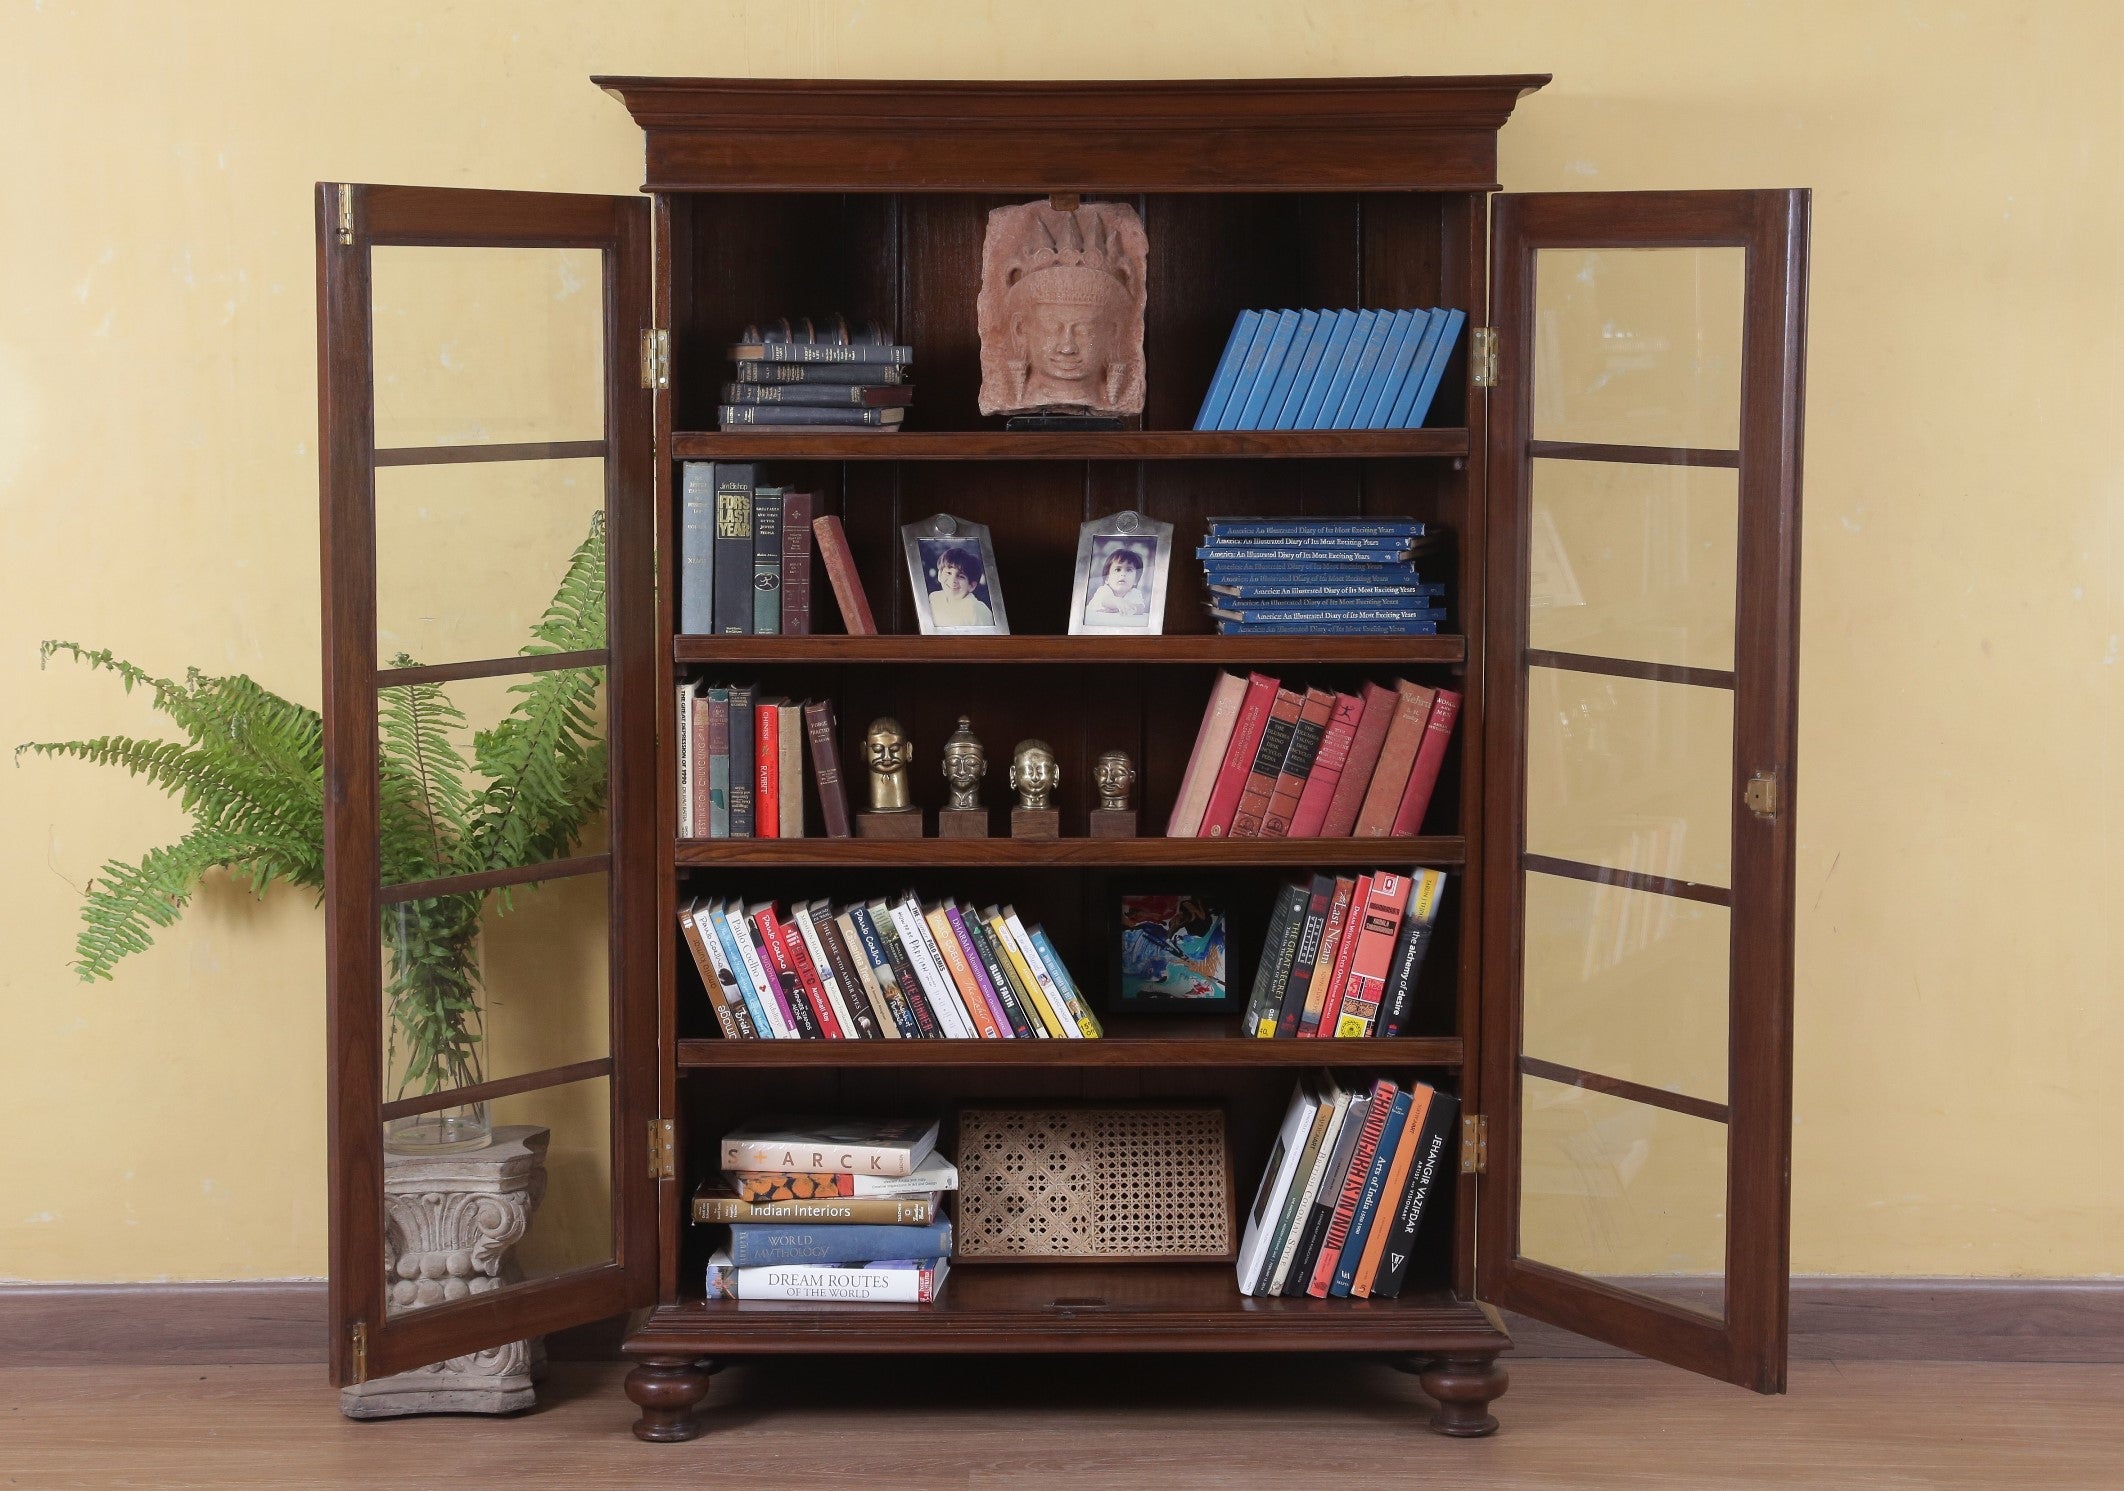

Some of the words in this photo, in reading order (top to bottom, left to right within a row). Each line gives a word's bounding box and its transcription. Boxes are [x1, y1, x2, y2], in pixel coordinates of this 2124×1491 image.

[719, 509, 750, 523] LAST
[719, 522, 750, 537] YEAR
[1247, 551, 1276, 559] Illustrated
[1277, 552, 1295, 562] Diary
[1312, 552, 1327, 560] Most
[1328, 552, 1353, 562] Exciting
[1354, 553, 1370, 561] Years
[1254, 537, 1284, 545] Illustrated
[1285, 537, 1302, 547] Diary
[1320, 538, 1335, 546] Most
[1337, 538, 1362, 548] Exciting
[1363, 538, 1379, 546] Years
[1323, 586, 1340, 595] Diary
[1374, 586, 1399, 595] Exciting
[1293, 612, 1324, 620] Illustrated
[1325, 612, 1342, 621] Diary
[1360, 612, 1374, 620] Most
[1375, 612, 1400, 621] Exciting
[1400, 611, 1417, 619] Years
[760, 765, 768, 795] RABBIT
[698, 786, 706, 836] DESTINATION
[1331, 902, 1343, 926] Last
[700, 916, 712, 940] Paulo
[709, 940, 724, 968] Coelho
[762, 914, 776, 939] Paulo
[772, 940, 787, 969] Coelho
[855, 909, 869, 934] Paulo
[865, 936, 881, 965] Coelho
[911, 907, 920, 918] THE
[926, 939, 936, 954] POLO
[933, 952, 946, 972] GAMES
[933, 915, 949, 939] PAULO
[946, 938, 965, 972] COELHO
[1291, 922, 1301, 940] THE
[1320, 926, 1341, 964] Nizam
[1410, 929, 1421, 945] the
[732, 918, 747, 944] Paulo
[743, 944, 761, 978] Coelho
[844, 930, 863, 967] Casuarina
[859, 966, 871, 983] Tree
[953, 918, 971, 952] DHARMA
[968, 952, 984, 982] Moments
[1283, 940, 1296, 969] GREAT
[1400, 944, 1417, 981] alchemy
[761, 954, 774, 984] BUDDHA
[821, 921, 829, 936] THE
[827, 936, 839, 956] HARE
[842, 971, 855, 994] AMBER
[851, 993, 862, 1010] EYES
[791, 945, 816, 986] Empire
[811, 987, 827, 1012] Arundhati
[821, 1010, 830, 1023] Roy
[990, 963, 1005, 986] BLIND
[1000, 986, 1015, 1009] FAITH
[1275, 970, 1289, 1001] SECRET
[1399, 979, 1409, 992] of
[902, 973, 917, 996] KITE
[911, 995, 933, 1031] RUNNER
[1392, 989, 1407, 1016] desire
[734, 1007, 750, 1035] Brida
[800, 1010, 813, 1031] STANDS
[1349, 1085, 1394, 1178] CHANDIGARH
[1309, 1152, 1326, 1189] BRITISH
[1373, 1155, 1386, 1176] Arts
[1413, 1160, 1423, 1180] ARTIST
[1420, 1134, 1443, 1185] JEHANGIR
[1369, 1175, 1380, 1187] of
[750, 1204, 790, 1217] Indian
[794, 1204, 851, 1217] Interiors
[1292, 1190, 1312, 1235] COLONIAL
[1337, 1194, 1357, 1211] IN
[1361, 1186, 1377, 1211] India
[1401, 1189, 1414, 1221] VISIONARY
[1405, 1186, 1428, 1234] VAZIFDAR
[768, 1235, 813, 1247] WORLD
[1324, 1211, 1351, 1251] INDIA
[754, 1246, 829, 1259] MYTHOLOGY
[1280, 1238, 1296, 1268] STYLE
[768, 1273, 823, 1287] DREAM
[828, 1275, 889, 1289] ROUTES
[786, 1287, 800, 1297] OF
[804, 1287, 828, 1297] THE
[831, 1288, 870, 1299] WORLD
